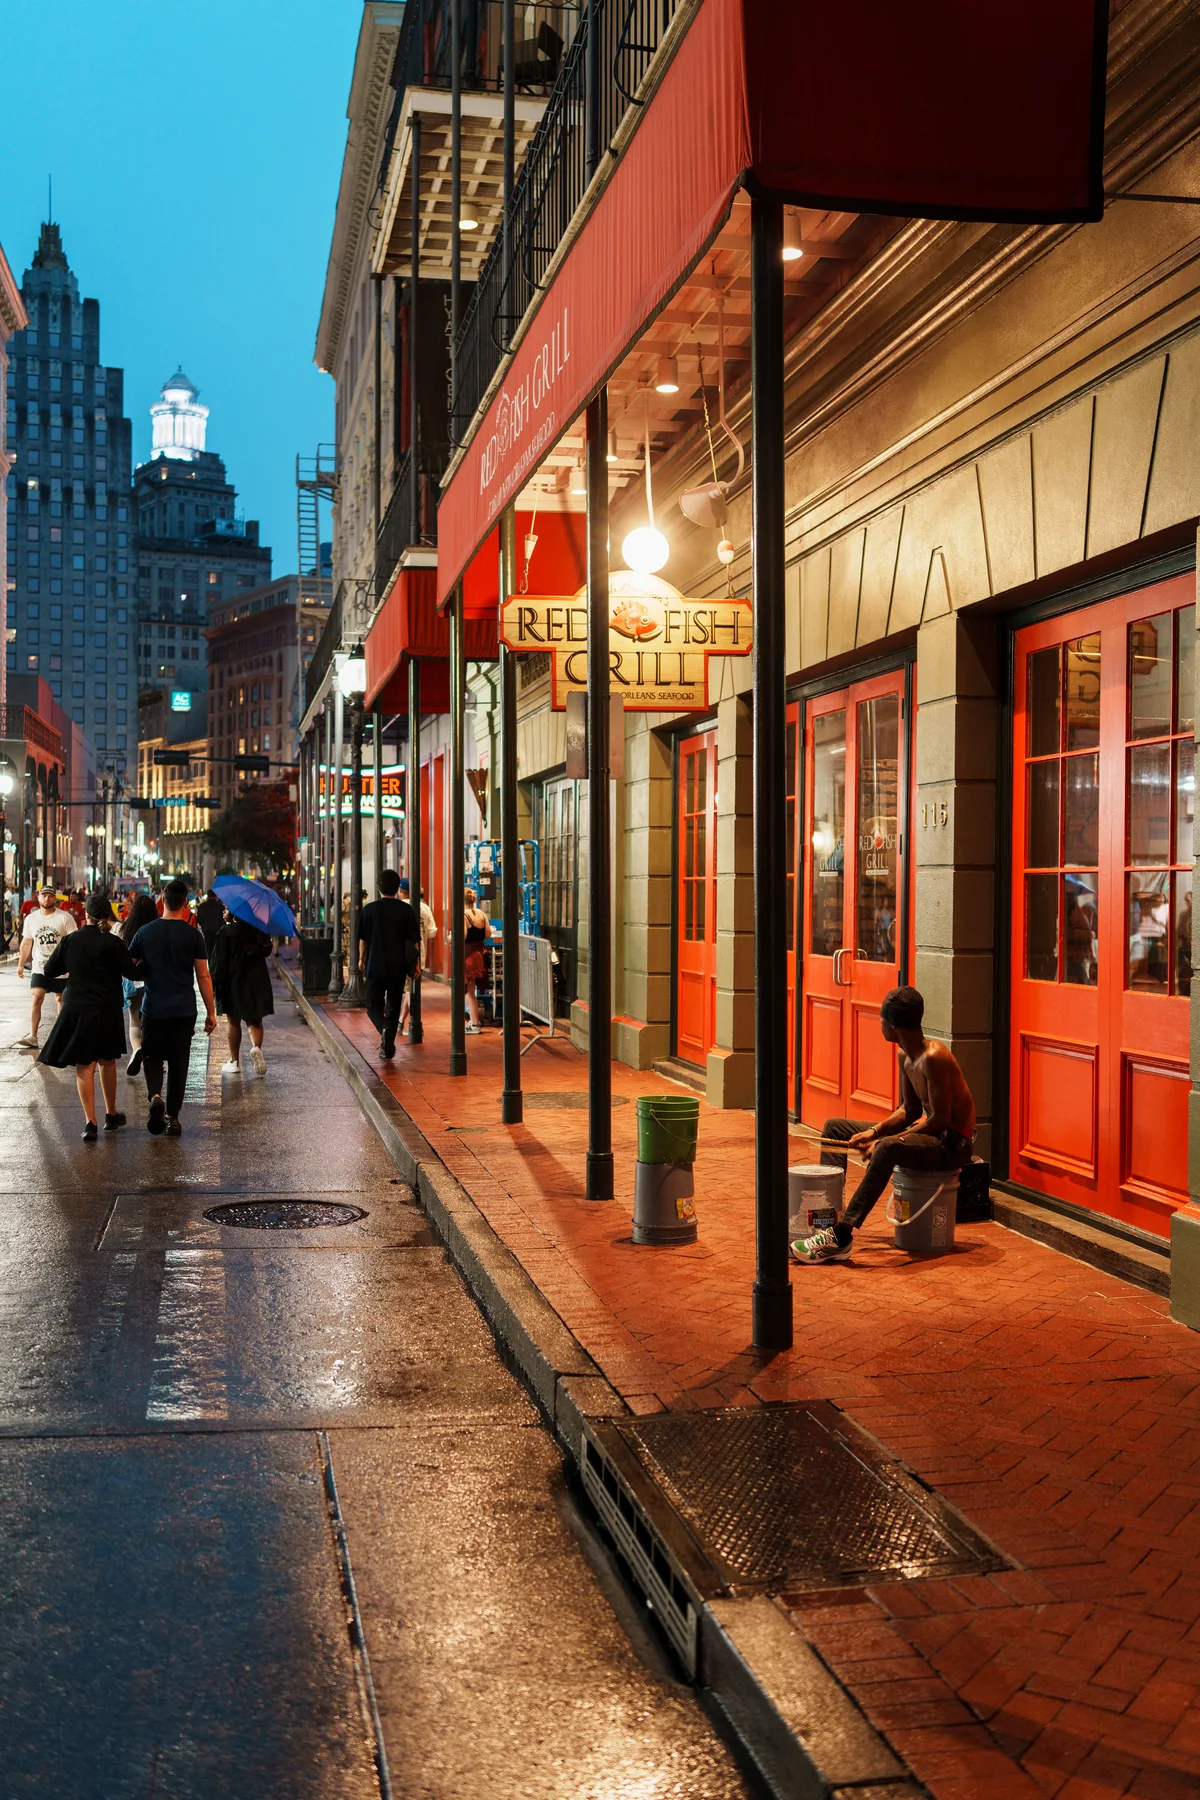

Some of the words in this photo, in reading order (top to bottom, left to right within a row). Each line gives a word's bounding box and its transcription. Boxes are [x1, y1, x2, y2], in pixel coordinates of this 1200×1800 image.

[479, 435, 498, 496] RED
[509, 373, 530, 450] FISH
[532, 307, 571, 410] GRILL
[517, 607, 588, 642] RED
[663, 610, 740, 645] FISH
[620, 692, 656, 701] ORLEANS
[658, 692, 695, 701] SEAFOOD
[922, 801, 948, 828] 115
[859, 835, 874, 850] RED
[882, 834, 897, 850] FISH
[819, 856, 838, 871] GRILL
[866, 853, 889, 869] GRILL
